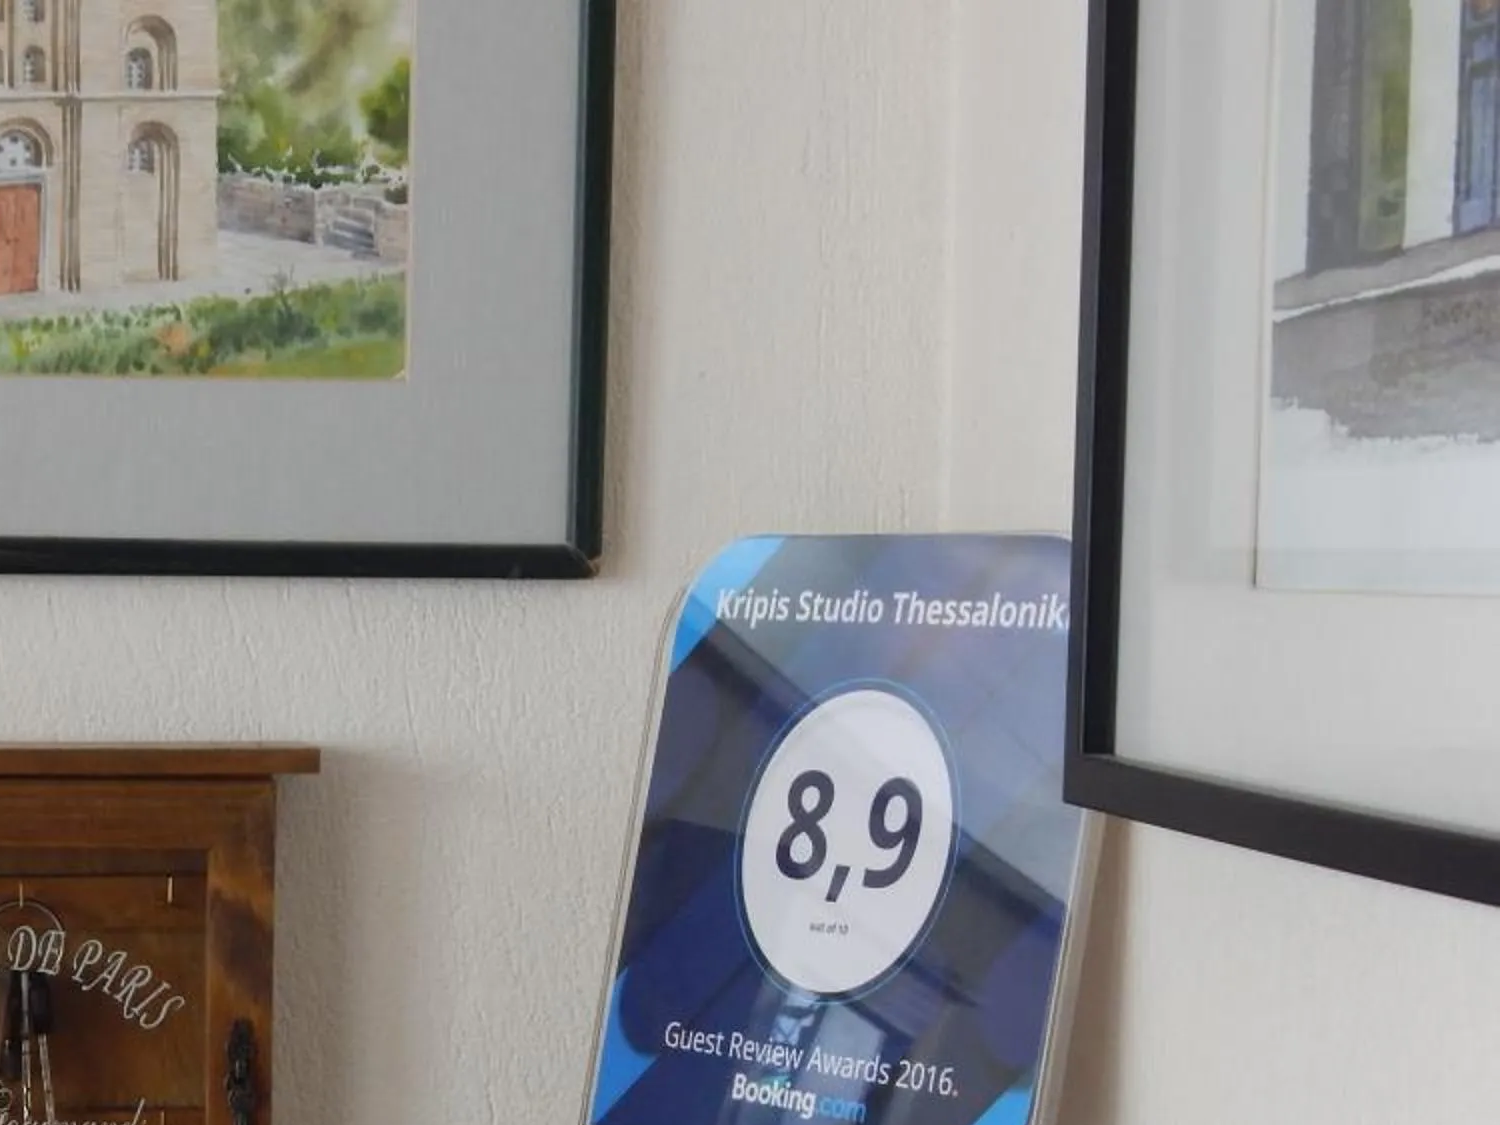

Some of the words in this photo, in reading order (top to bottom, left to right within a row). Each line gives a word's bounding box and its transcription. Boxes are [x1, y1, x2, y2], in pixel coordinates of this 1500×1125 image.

[715, 588, 789, 628] Kripis
[796, 589, 883, 624] Studio
[892, 592, 1070, 630] Thessalonik
[775, 769, 924, 903] 8,9
[8, 925, 66, 976] DE
[71, 938, 186, 1031] PARIS
[664, 1021, 723, 1057] Guest
[729, 1029, 802, 1070] Review
[806, 1048, 890, 1086] Awards
